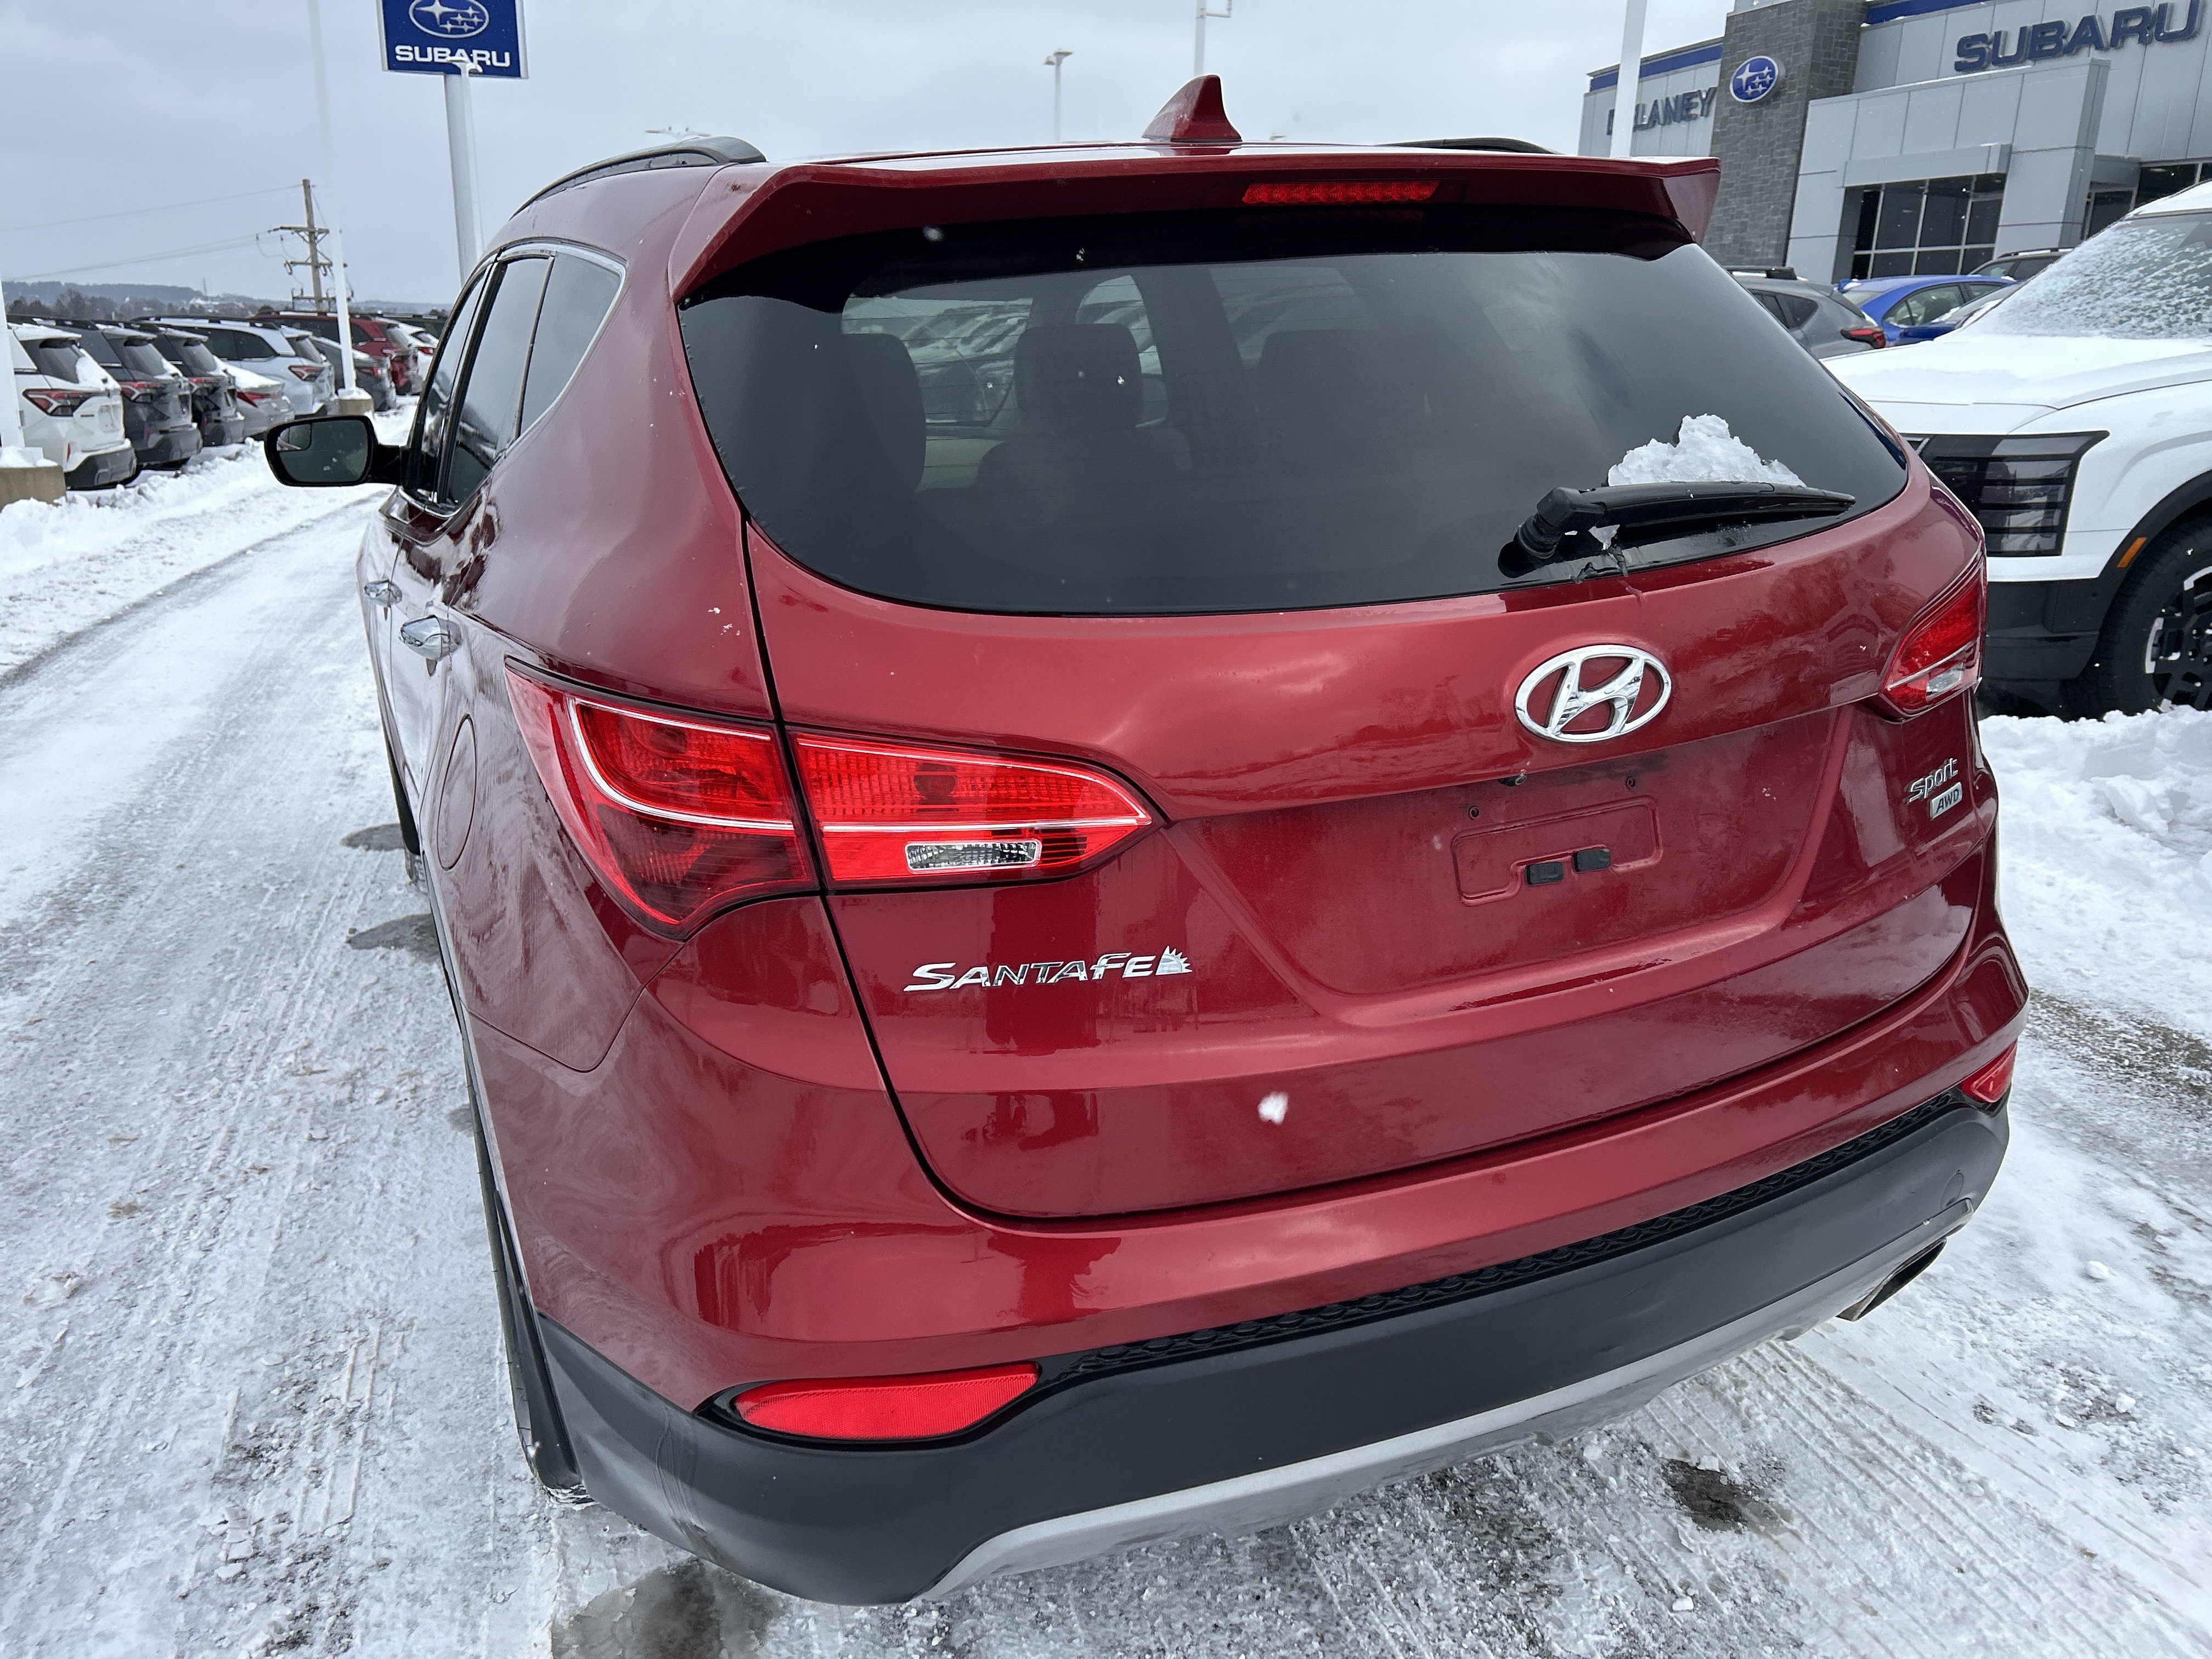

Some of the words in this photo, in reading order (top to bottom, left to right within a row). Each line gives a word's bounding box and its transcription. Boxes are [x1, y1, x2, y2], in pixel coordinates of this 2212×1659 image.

[1954, 0, 2202, 72] SUBARU
[394, 45, 511, 67] SUBARU
[1606, 87, 1718, 136] LANEY
[1935, 788, 1960, 814] AWD
